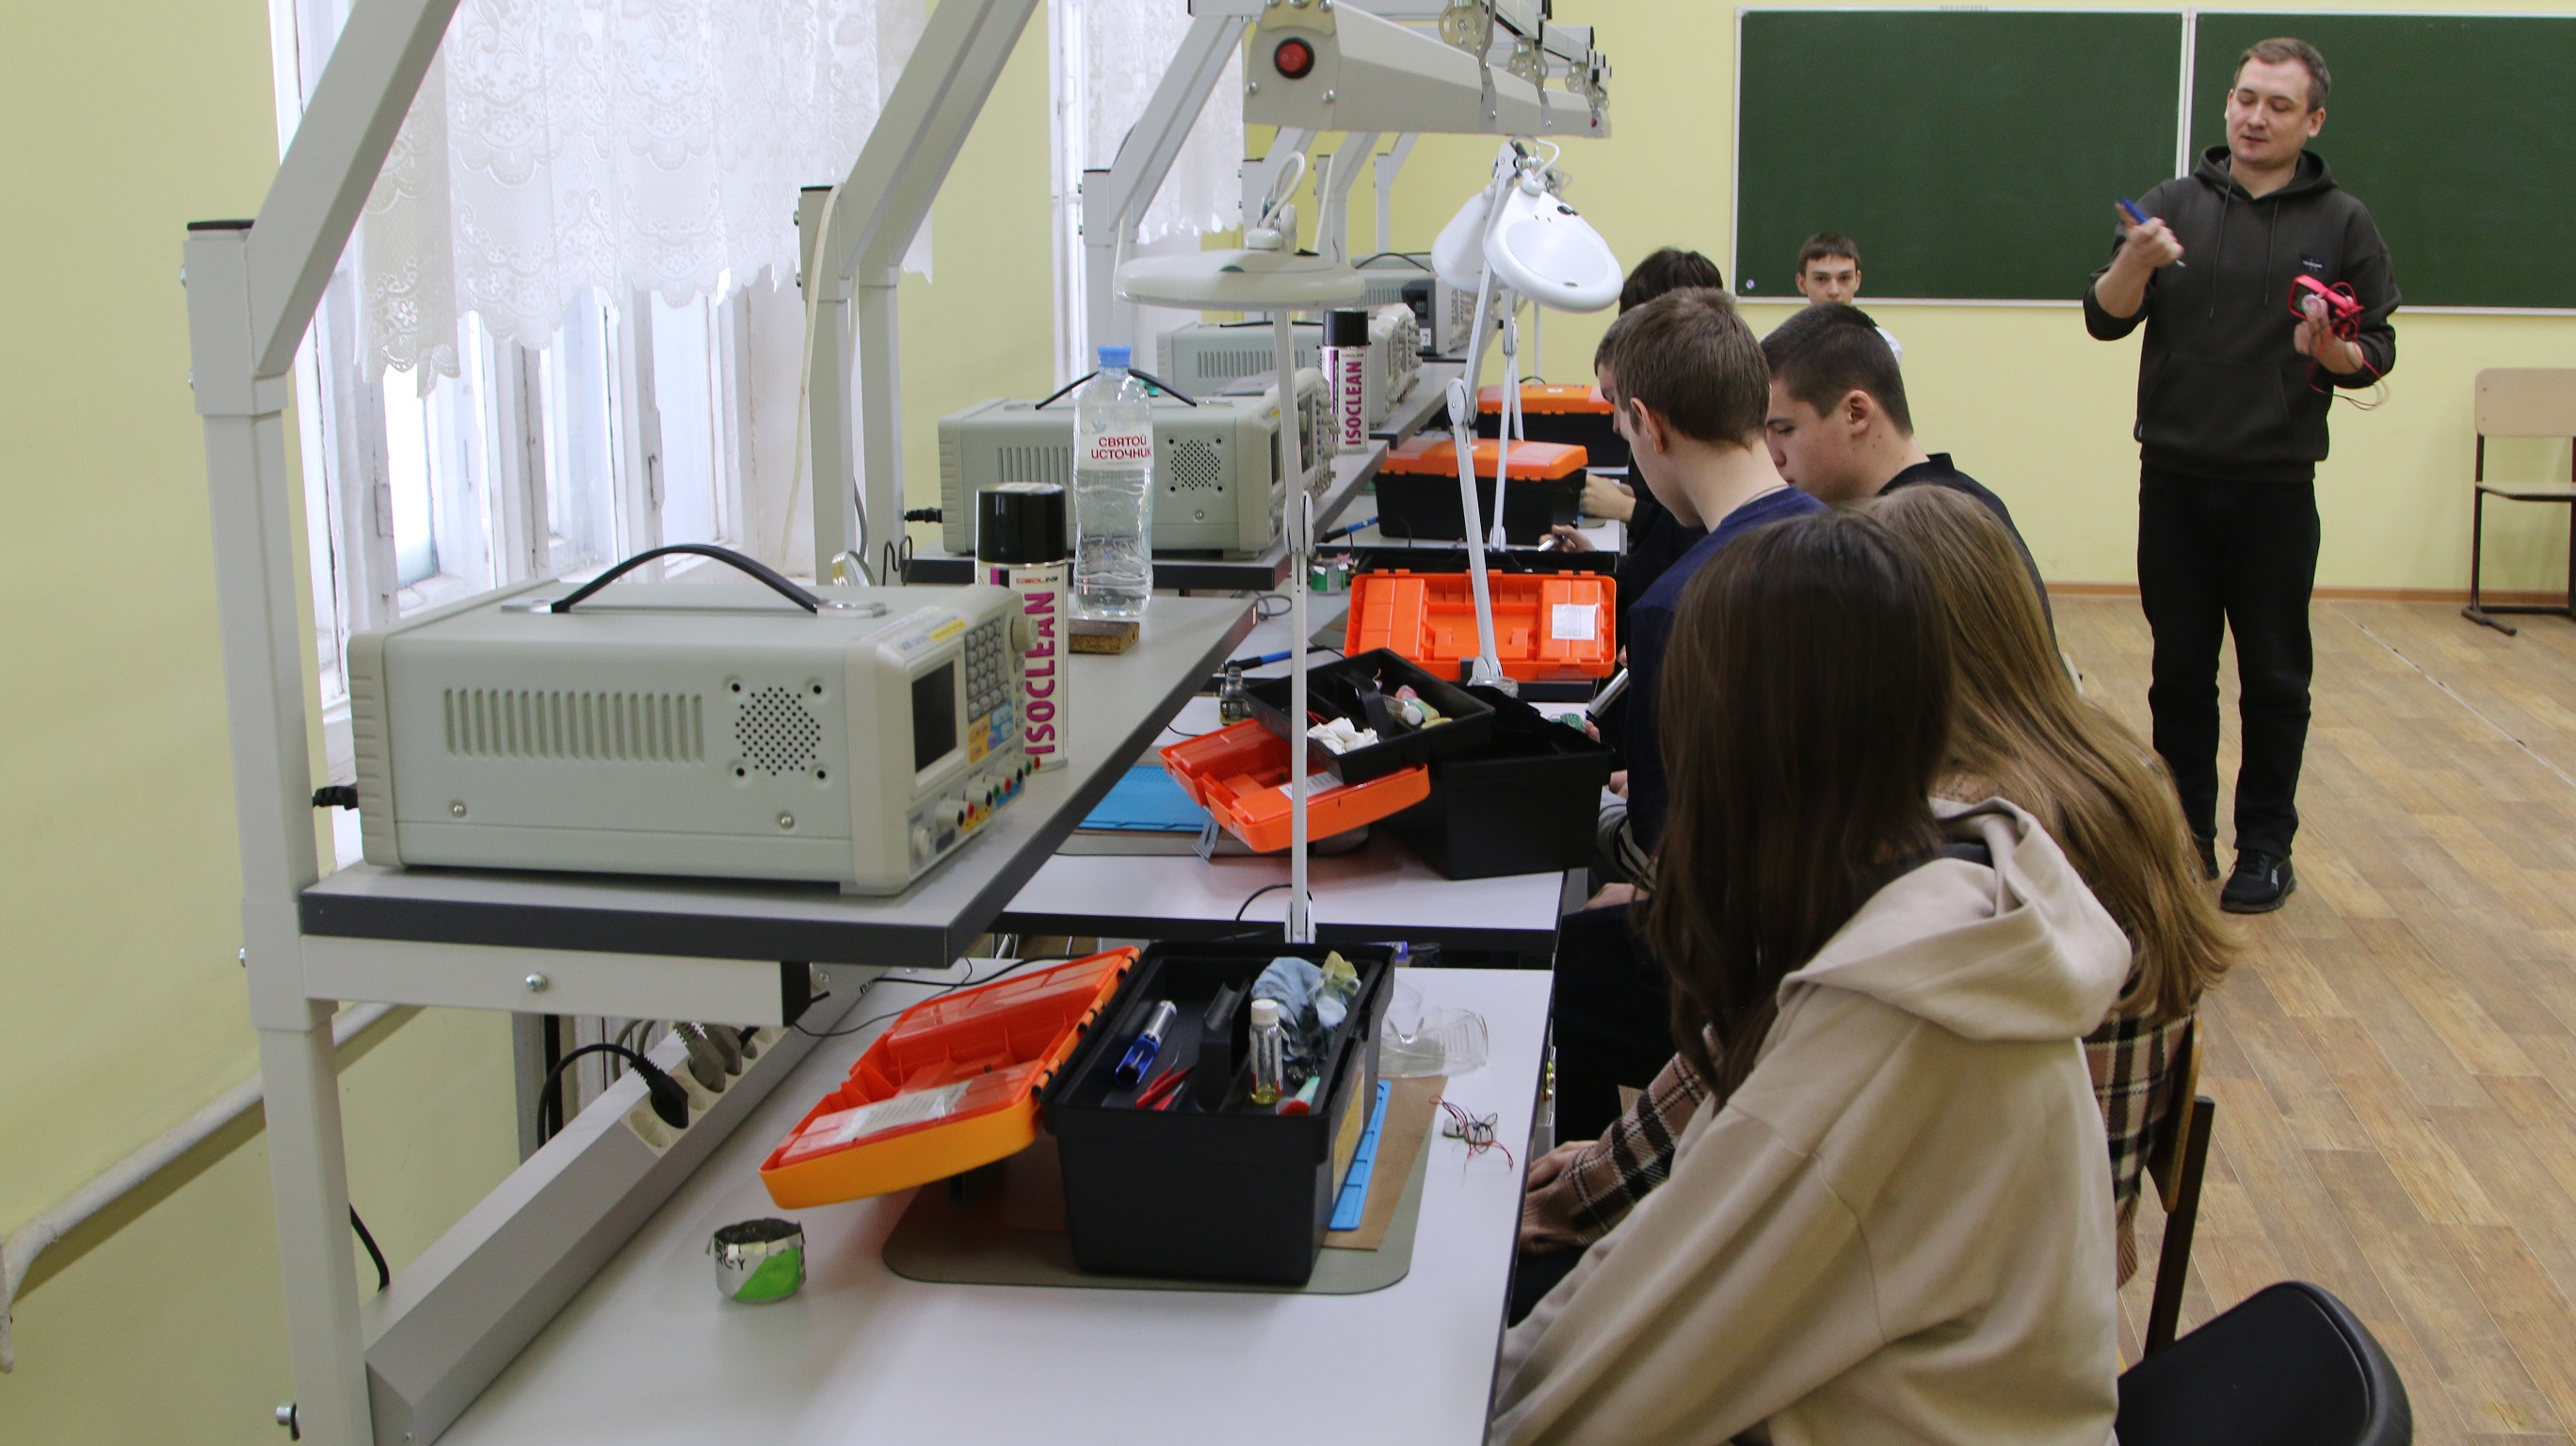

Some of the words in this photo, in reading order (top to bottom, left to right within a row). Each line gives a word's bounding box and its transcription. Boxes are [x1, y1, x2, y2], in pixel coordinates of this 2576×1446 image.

[1345, 362, 1362, 445] ISOCLEAN
[1091, 446, 1151, 459] ИСТОЧНИК
[1098, 433, 1147, 447] СВЯТОЙ
[1023, 592, 1055, 755] ISOCLEAN
